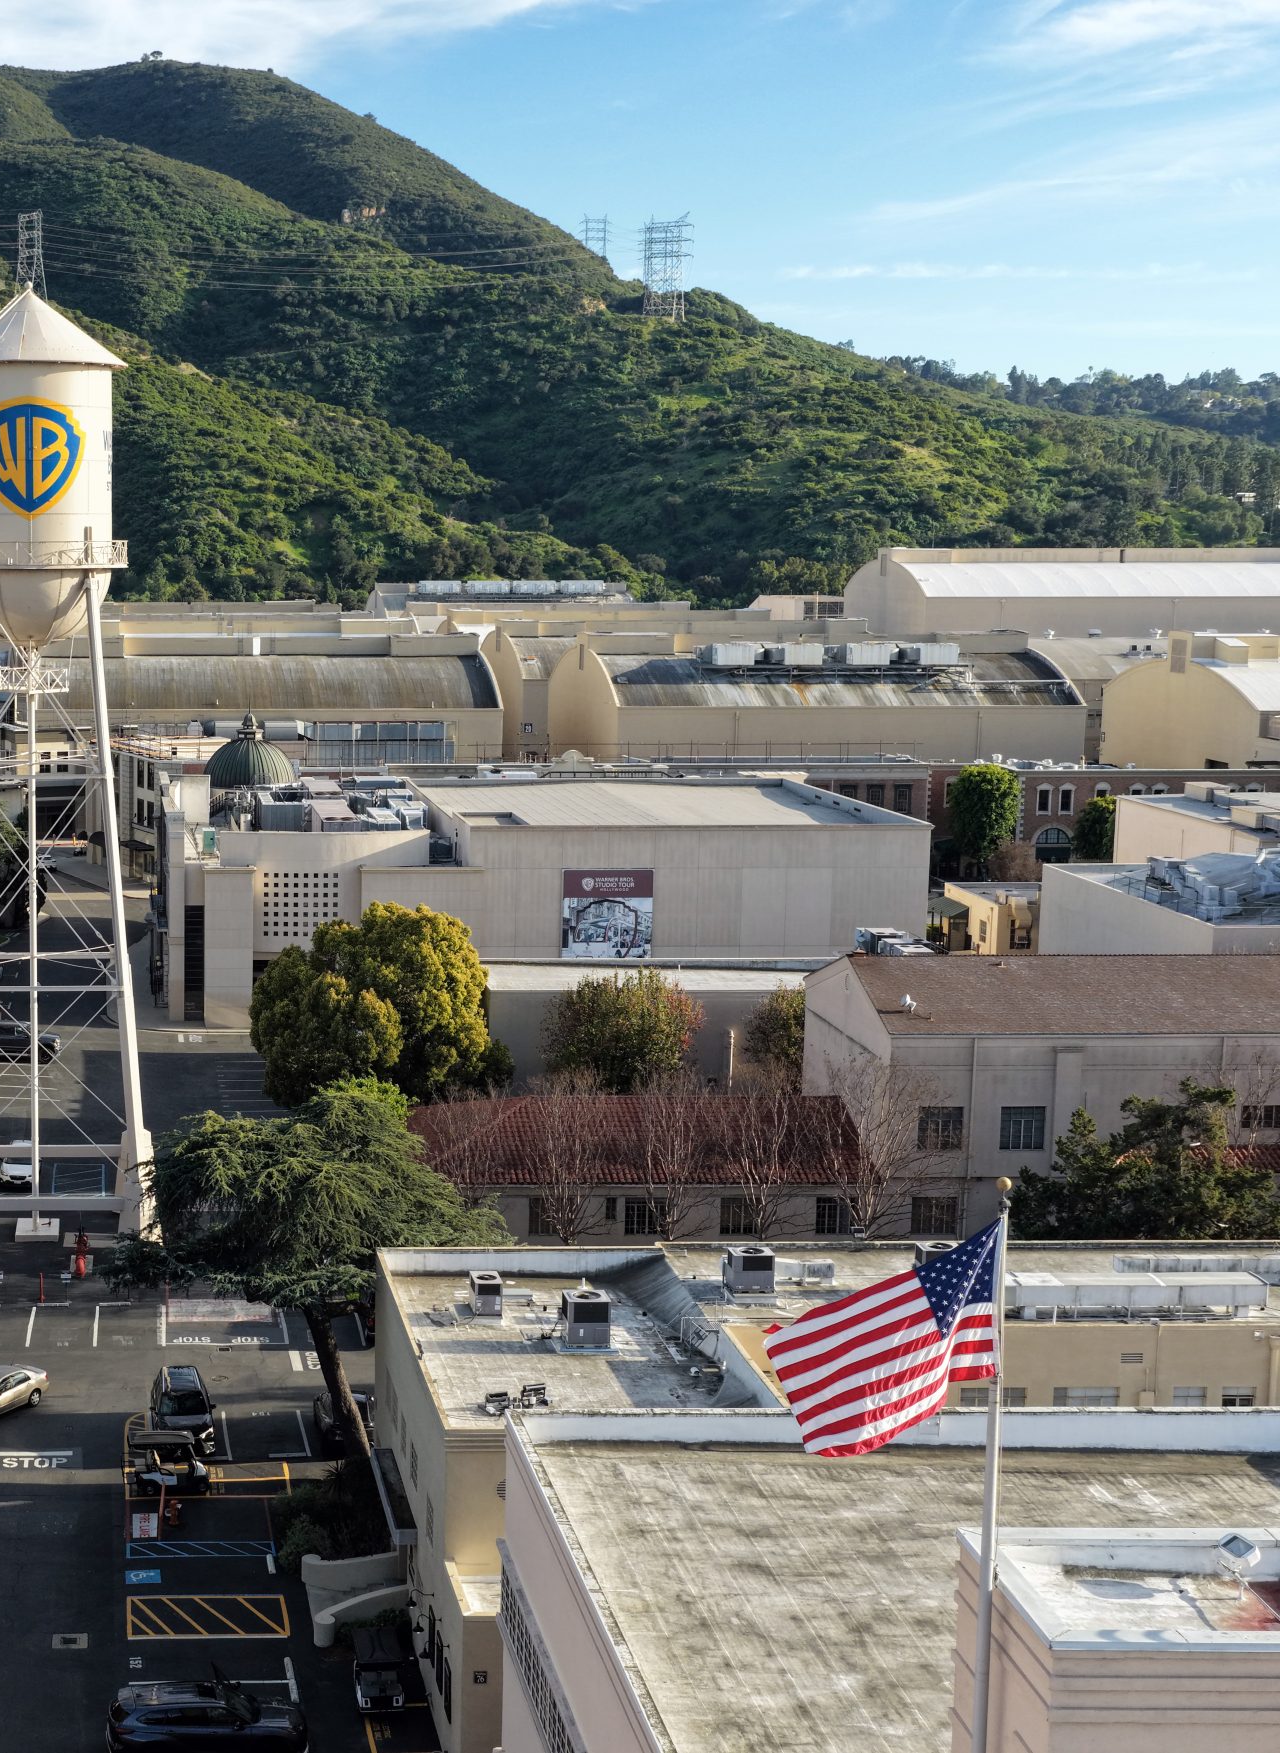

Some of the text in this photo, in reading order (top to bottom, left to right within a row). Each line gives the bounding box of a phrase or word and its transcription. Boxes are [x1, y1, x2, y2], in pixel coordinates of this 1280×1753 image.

[2, 1457, 68, 1469] STOP
[129, 1656, 142, 1669] 152
[476, 1675, 485, 1683] 76
